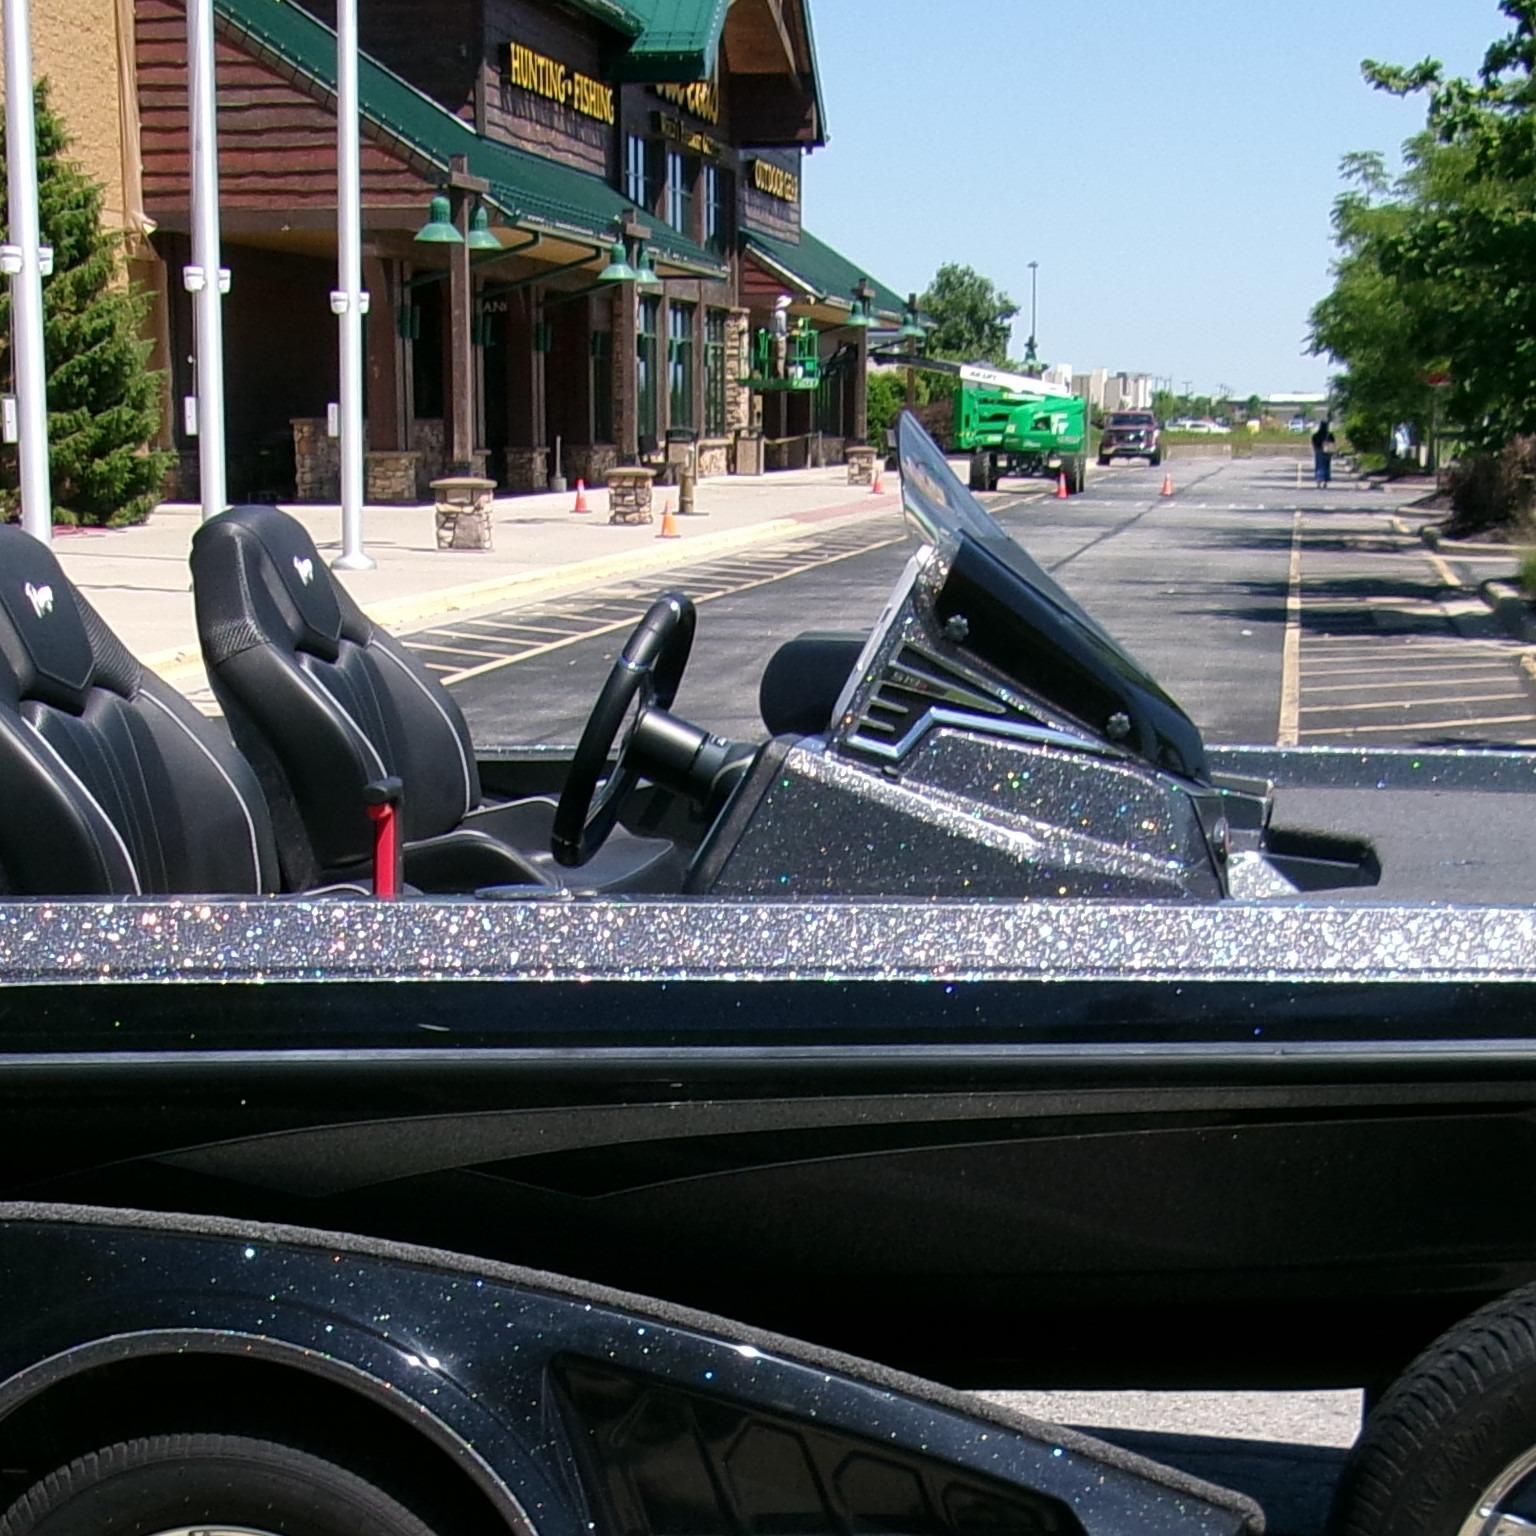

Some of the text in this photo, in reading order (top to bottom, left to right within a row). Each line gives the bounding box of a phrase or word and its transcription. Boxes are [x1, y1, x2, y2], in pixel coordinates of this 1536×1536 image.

[510, 42, 566, 102] HUNTING
[573, 72, 615, 126] FISHING
[754, 160, 784, 198] OUTDOOR
